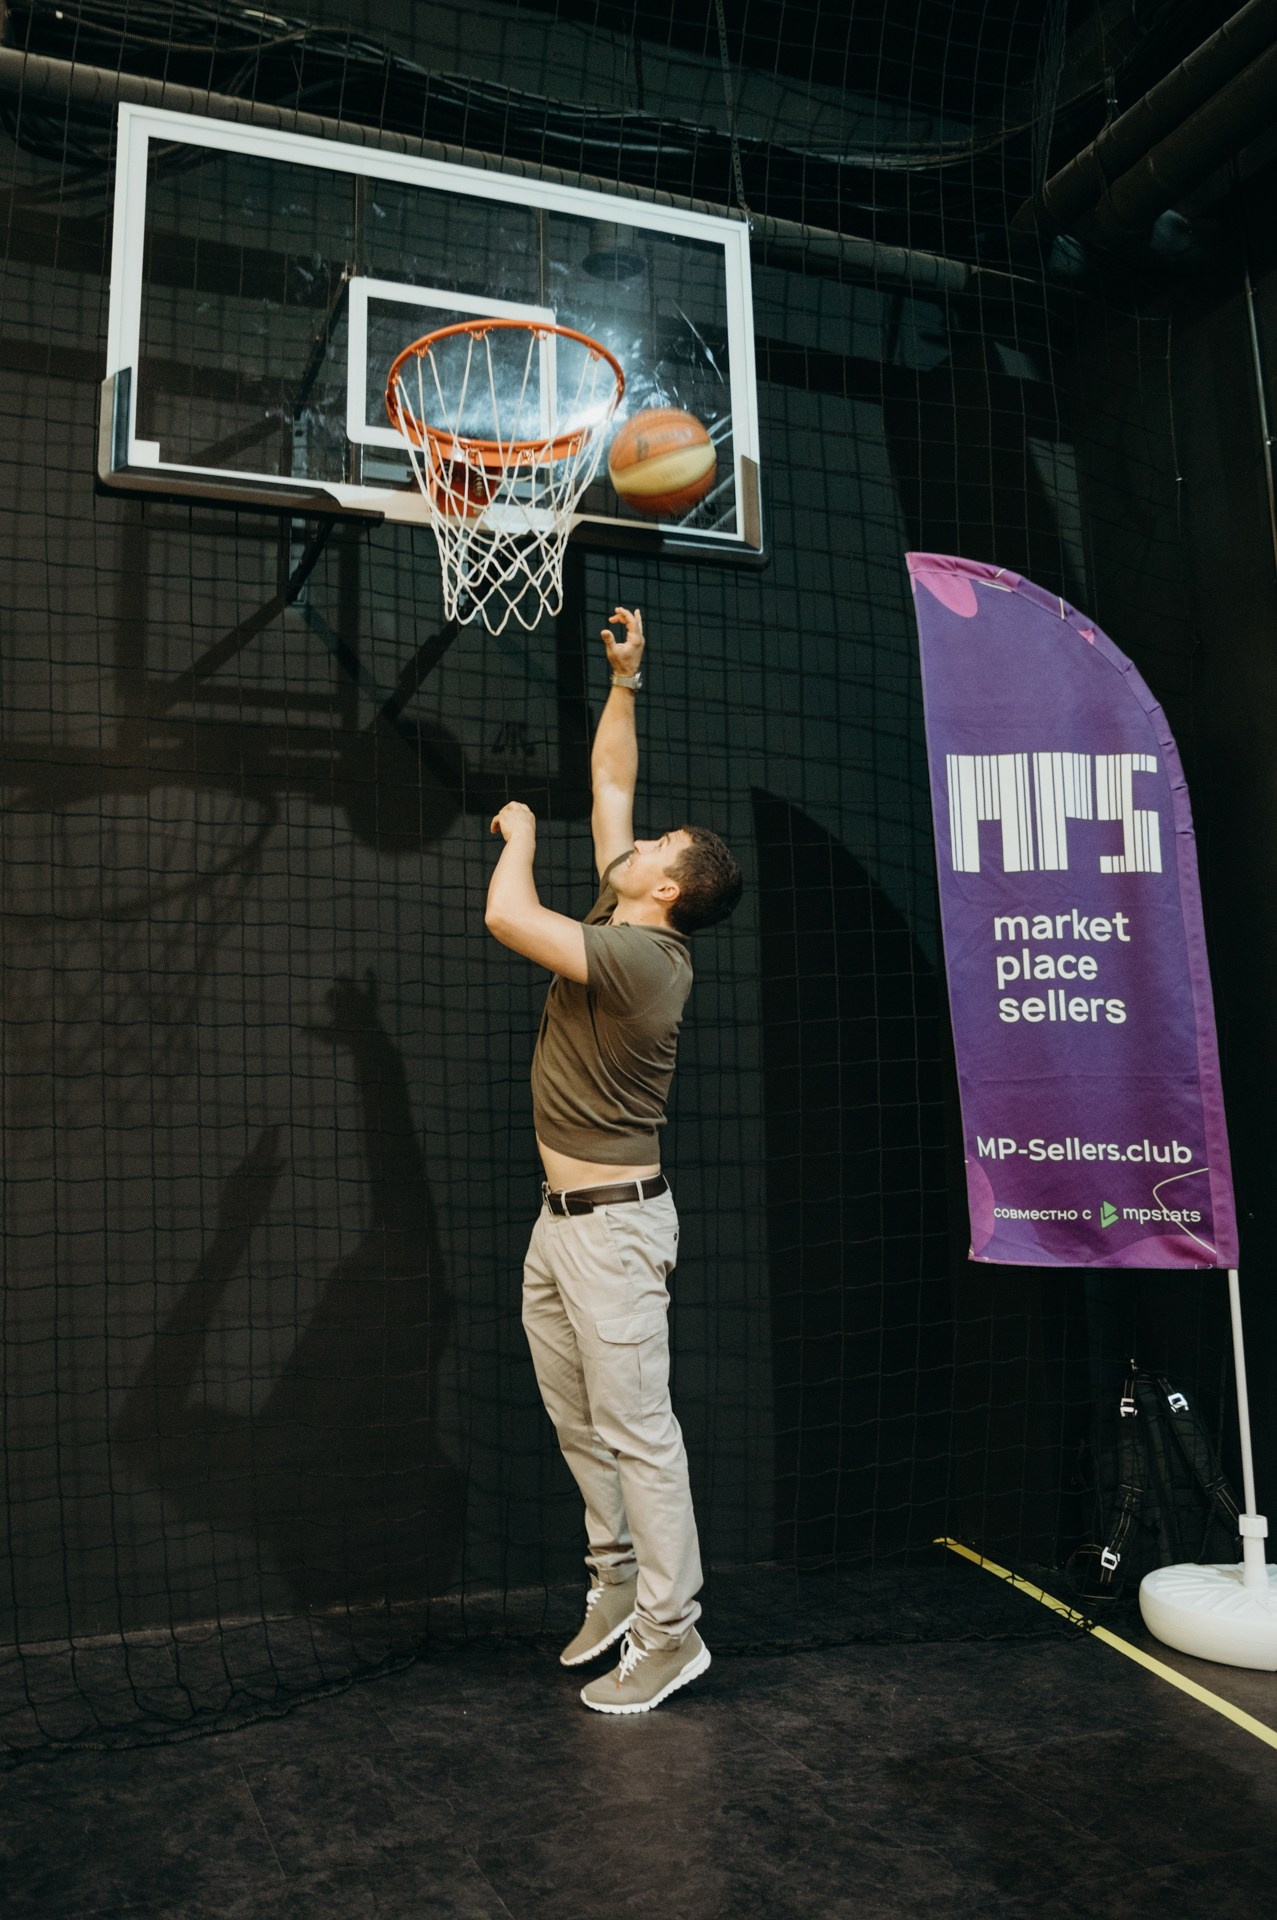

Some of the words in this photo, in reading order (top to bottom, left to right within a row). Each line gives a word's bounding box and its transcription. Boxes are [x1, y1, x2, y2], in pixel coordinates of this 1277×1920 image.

[993, 908, 1131, 942] market
[996, 948, 1098, 990] place
[998, 989, 1127, 1023] sellers
[976, 1135, 1192, 1164] MP-Sellers.club
[993, 1207, 1078, 1220] совместно
[1122, 1207, 1201, 1225] mpstats
